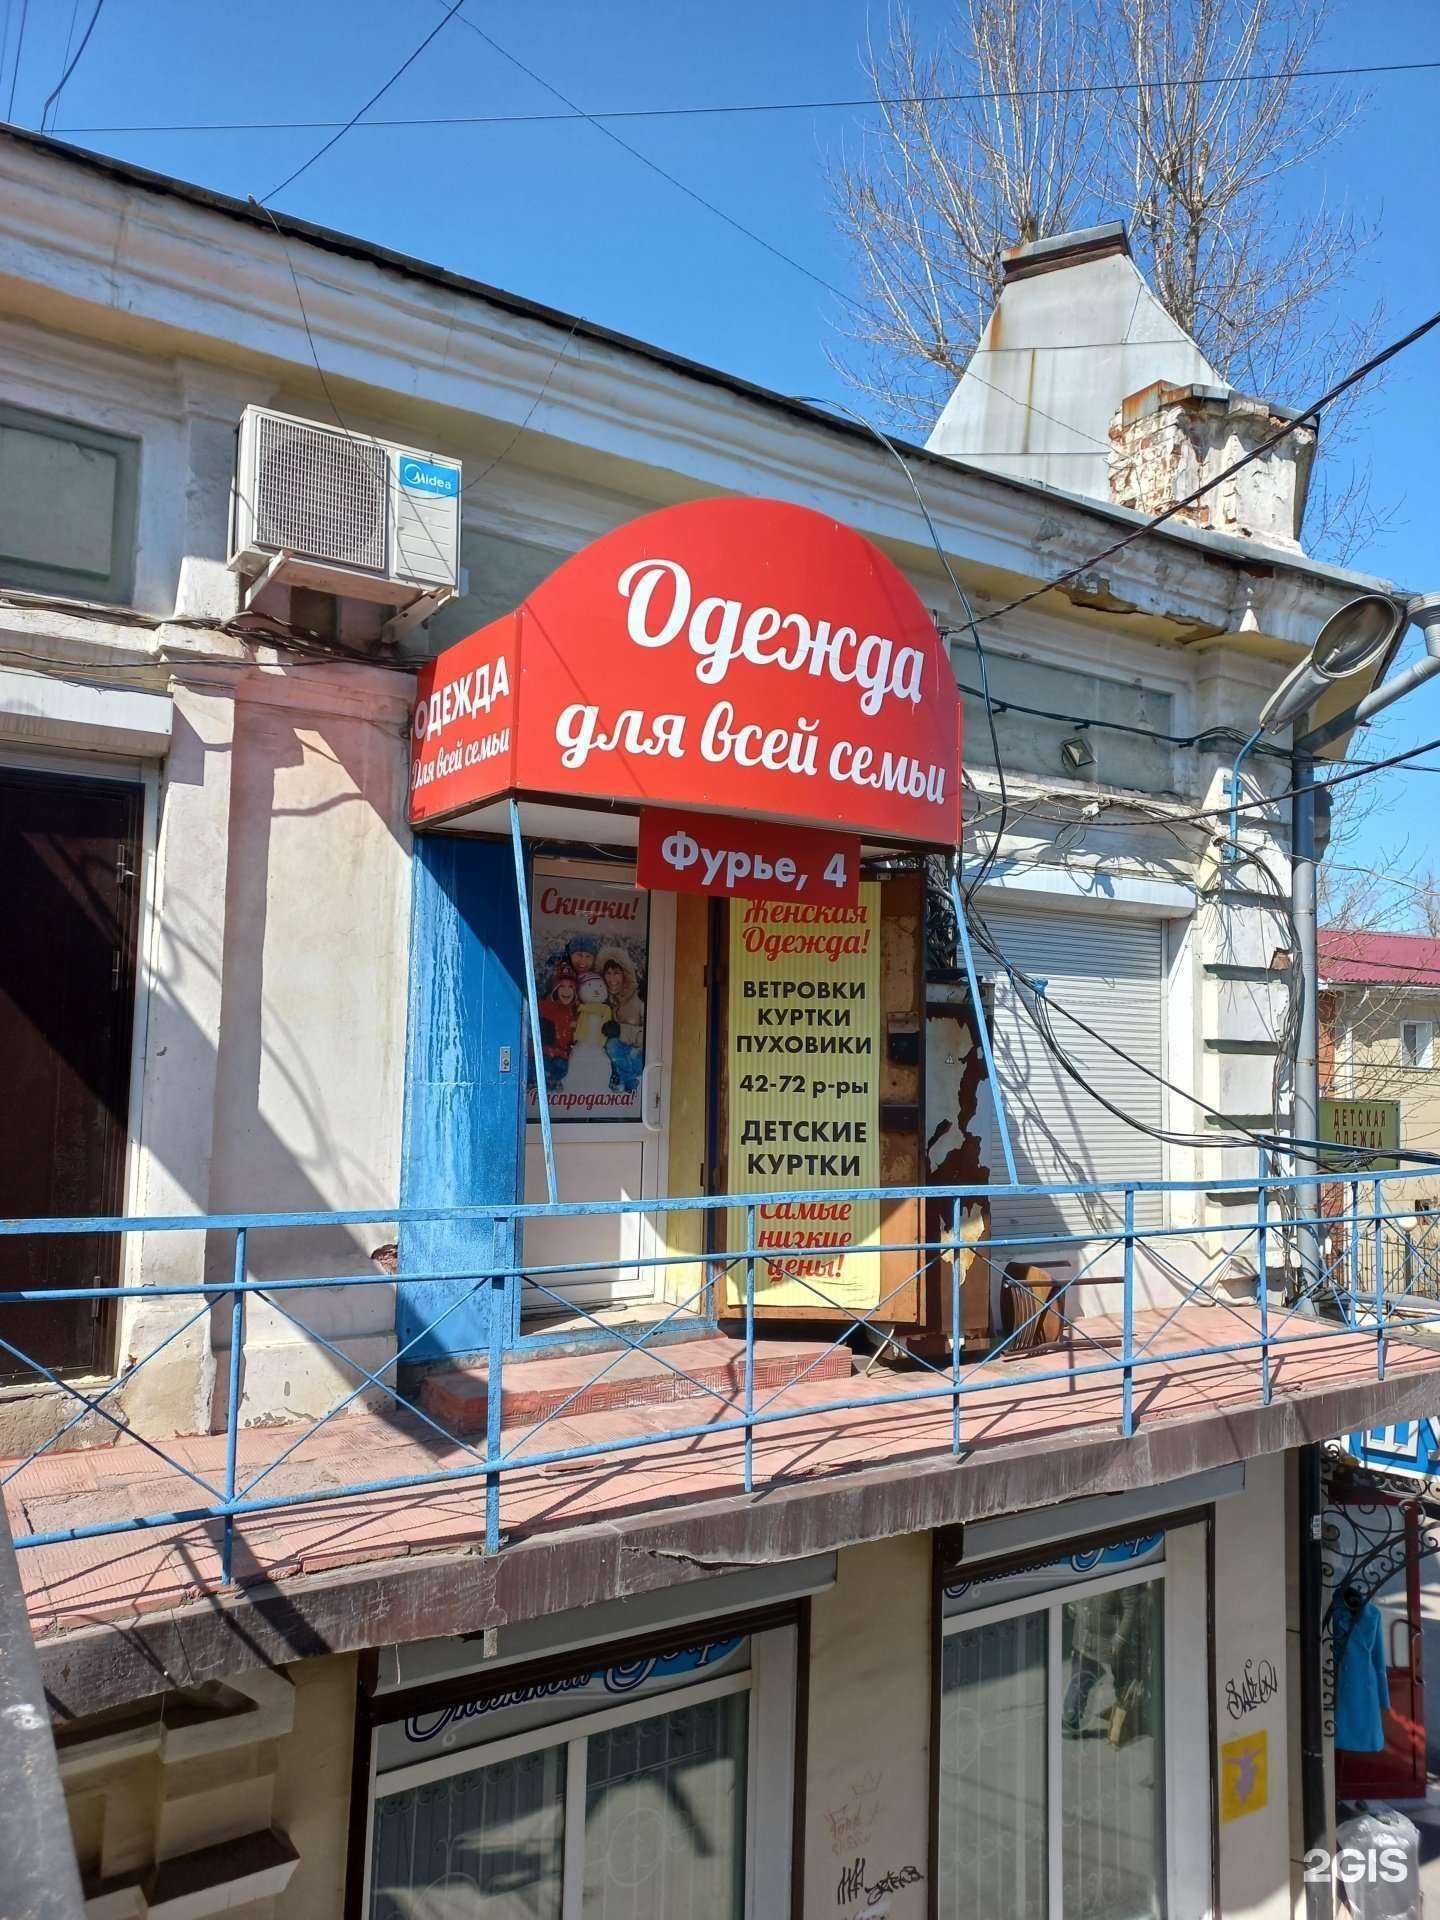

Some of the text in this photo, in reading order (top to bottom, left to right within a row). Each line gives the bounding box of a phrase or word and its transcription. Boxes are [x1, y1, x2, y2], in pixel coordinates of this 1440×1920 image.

[404, 463, 451, 489] Midea
[617, 558, 925, 716] Одежда
[415, 656, 510, 741] ОДЕЖДА
[411, 727, 510, 791] Для всей семьи
[554, 700, 947, 805] для всей семьи
[661, 830, 847, 890] Фурье, 4
[540, 888, 640, 925] Скидки!
[743, 899, 868, 924] Женская
[742, 926, 871, 962] Одежда!
[743, 981, 866, 999] ВЕТРОВКИ
[758, 1008, 851, 1027] КУРТКИ
[736, 1035, 872, 1054] ПУХОВИКИ
[739, 1074, 869, 1099] 42-72 р-ры
[1333, 1108, 1386, 1129] ДЕТСКАЯ
[740, 1119, 867, 1146] ДЕТСКИЕ
[1335, 1130, 1383, 1148] ОДЕЖДА
[747, 1153, 860, 1177] КУРТКИ
[760, 1202, 852, 1221] Самые
[758, 1230, 852, 1249] низкие
[767, 1254, 845, 1284] цены!
